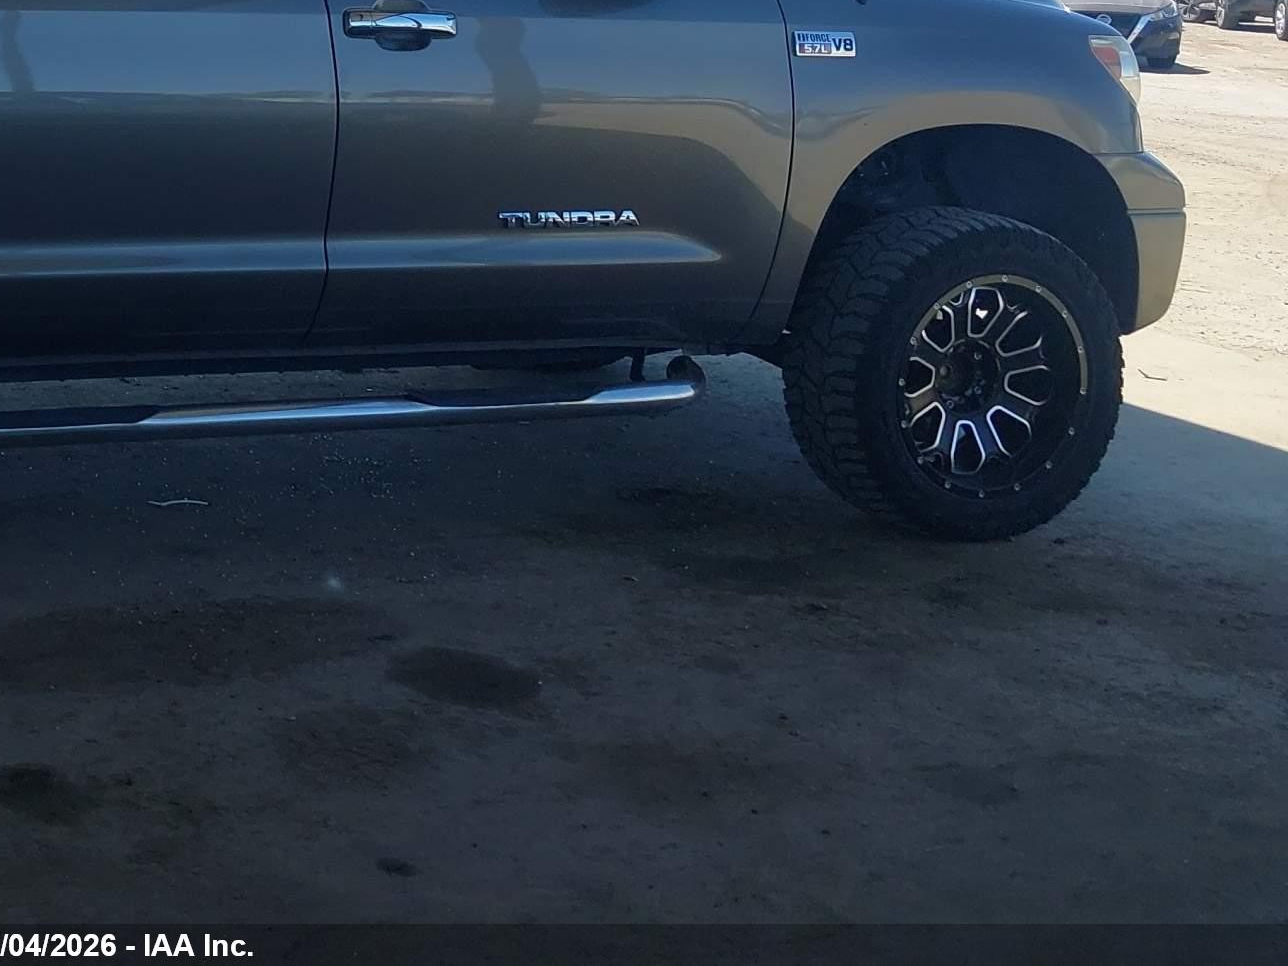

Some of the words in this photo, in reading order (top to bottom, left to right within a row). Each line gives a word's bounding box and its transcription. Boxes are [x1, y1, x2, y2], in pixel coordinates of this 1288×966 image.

[804, 43, 829, 53] 5.7L
[832, 38, 854, 51] V8
[499, 210, 640, 227] TUNDRA
